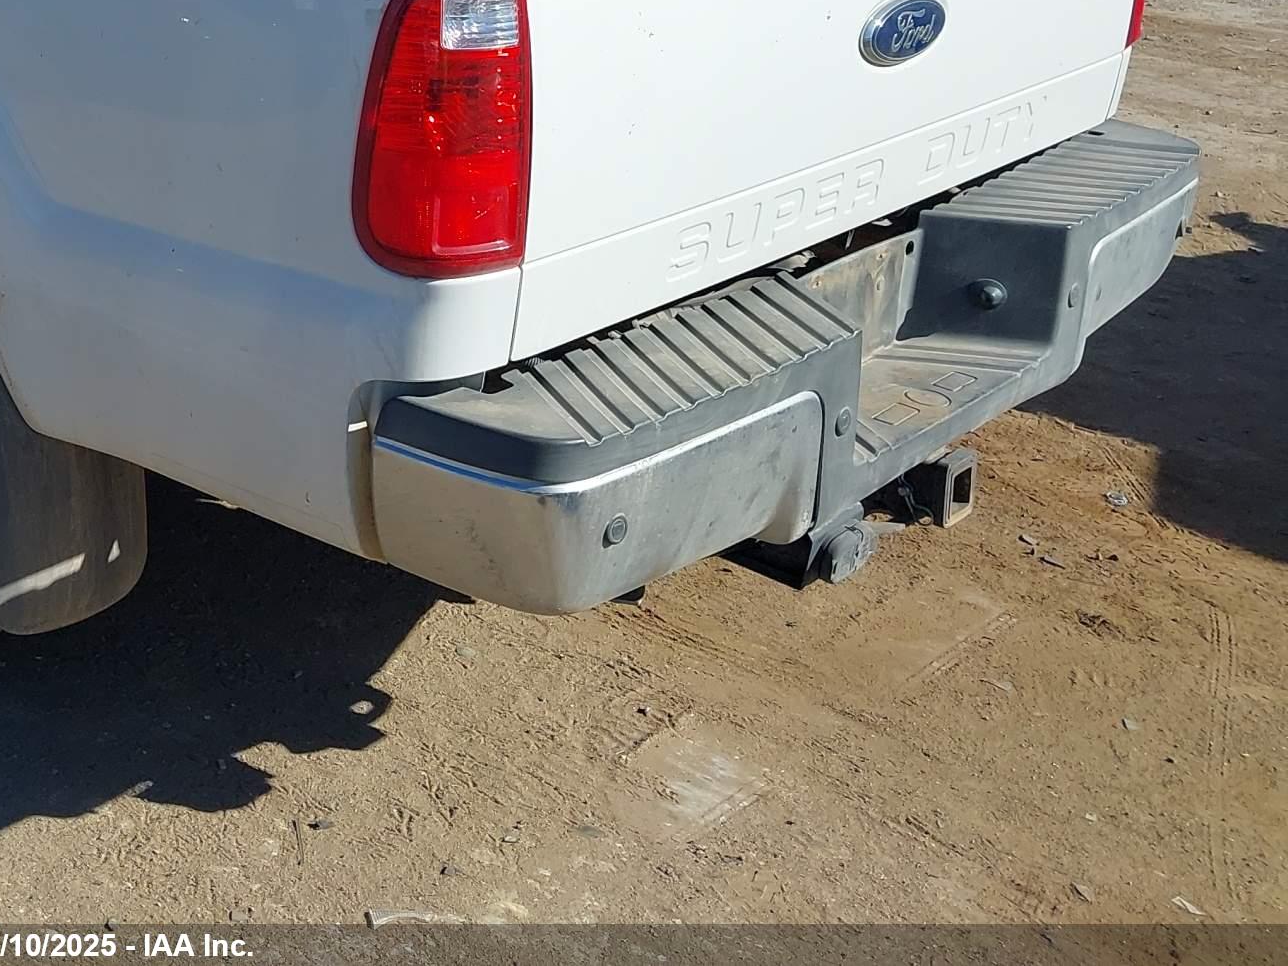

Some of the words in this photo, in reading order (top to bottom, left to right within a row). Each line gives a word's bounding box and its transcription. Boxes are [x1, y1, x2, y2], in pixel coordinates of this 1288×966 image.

[891, 8, 936, 53] Ford
[665, 158, 885, 283] SUPER
[916, 95, 1048, 187] DUTY
